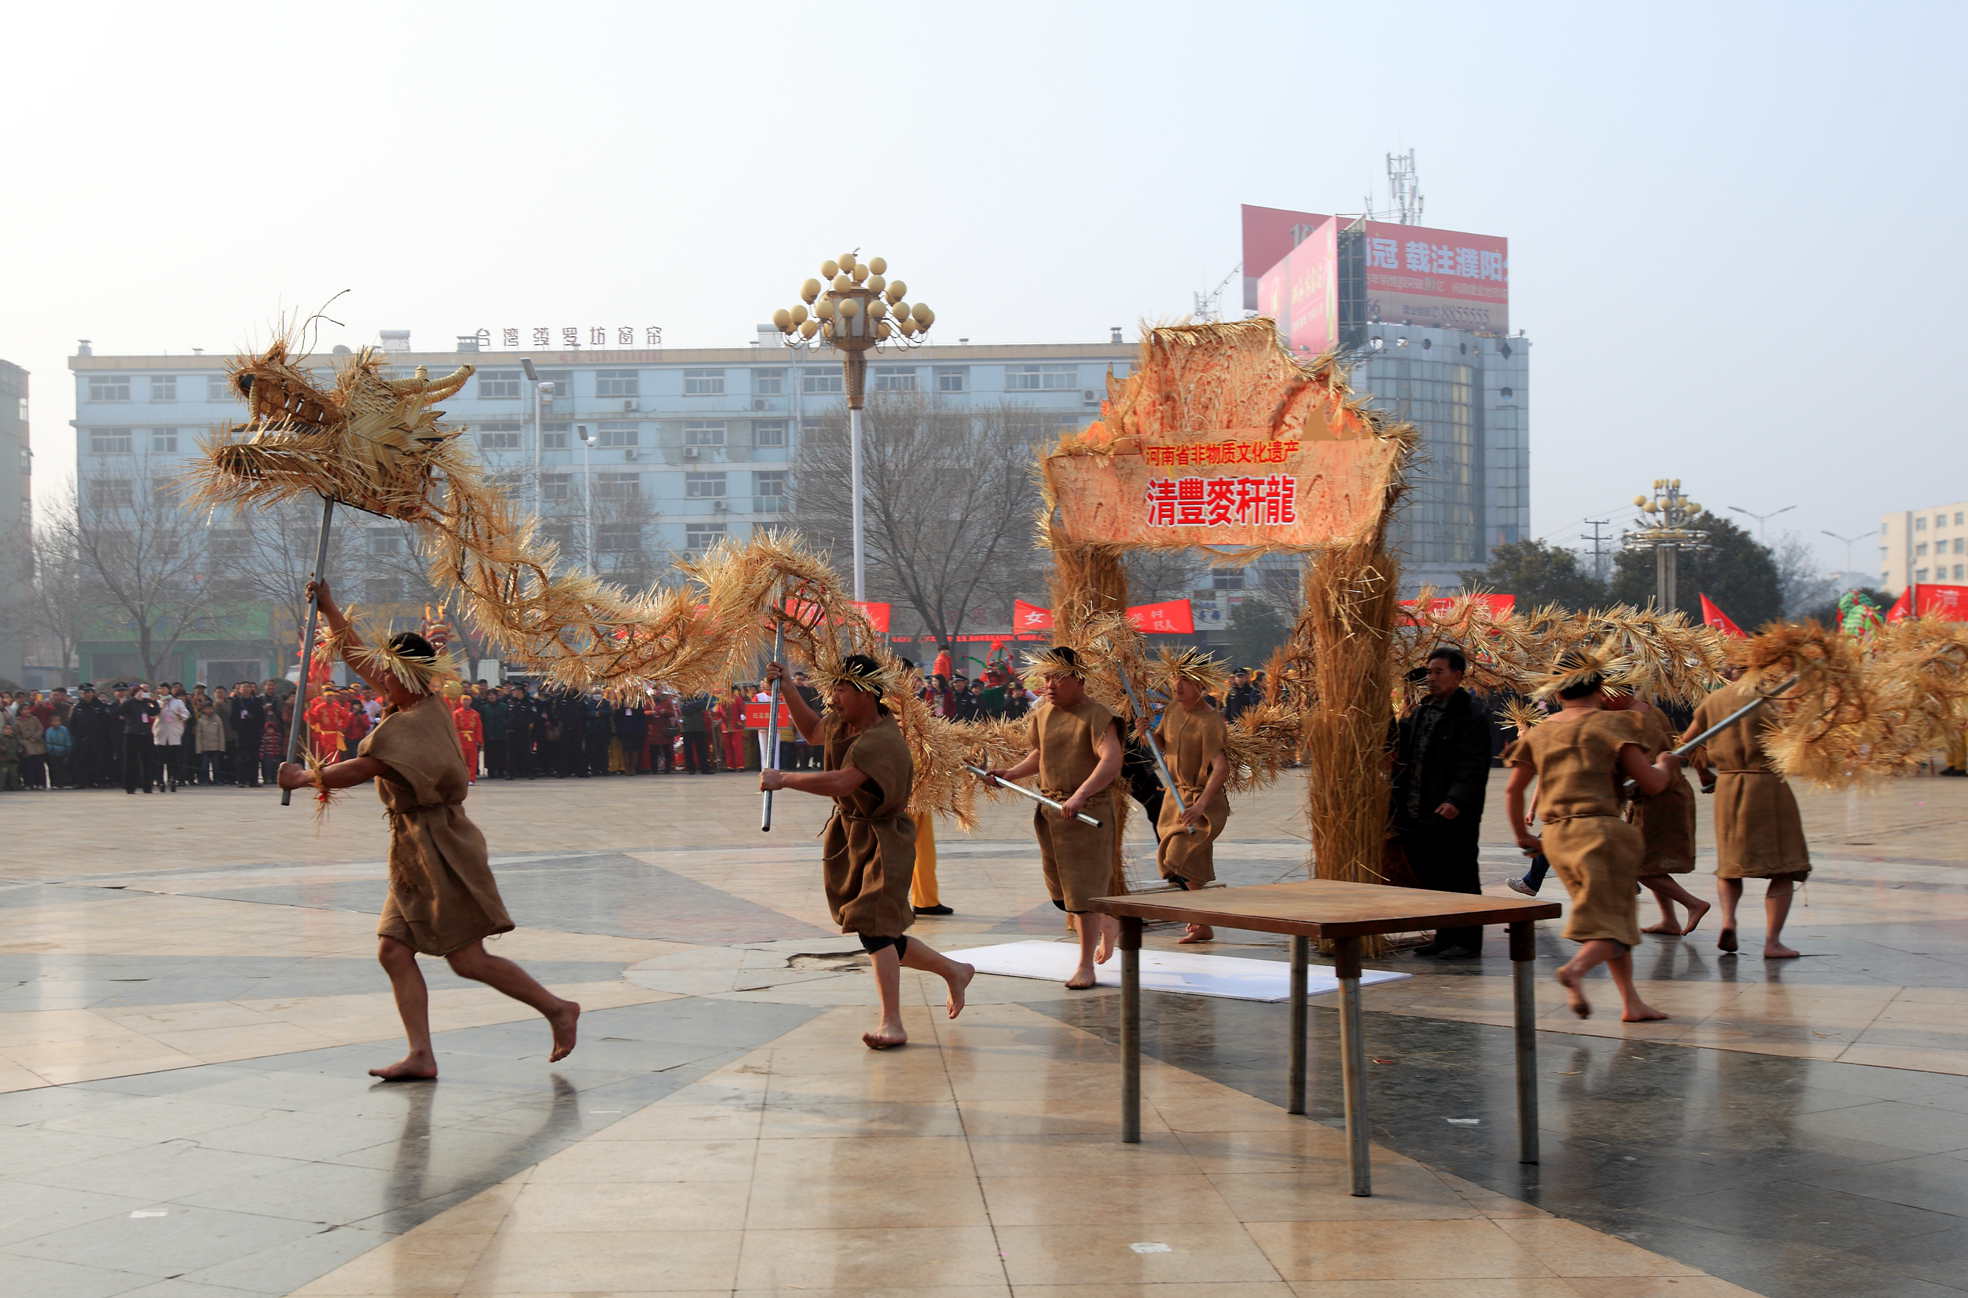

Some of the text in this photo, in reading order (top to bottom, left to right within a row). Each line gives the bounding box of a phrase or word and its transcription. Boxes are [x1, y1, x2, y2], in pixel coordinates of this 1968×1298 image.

[1145, 441, 1300, 467] 河南省非物质文化遗产
